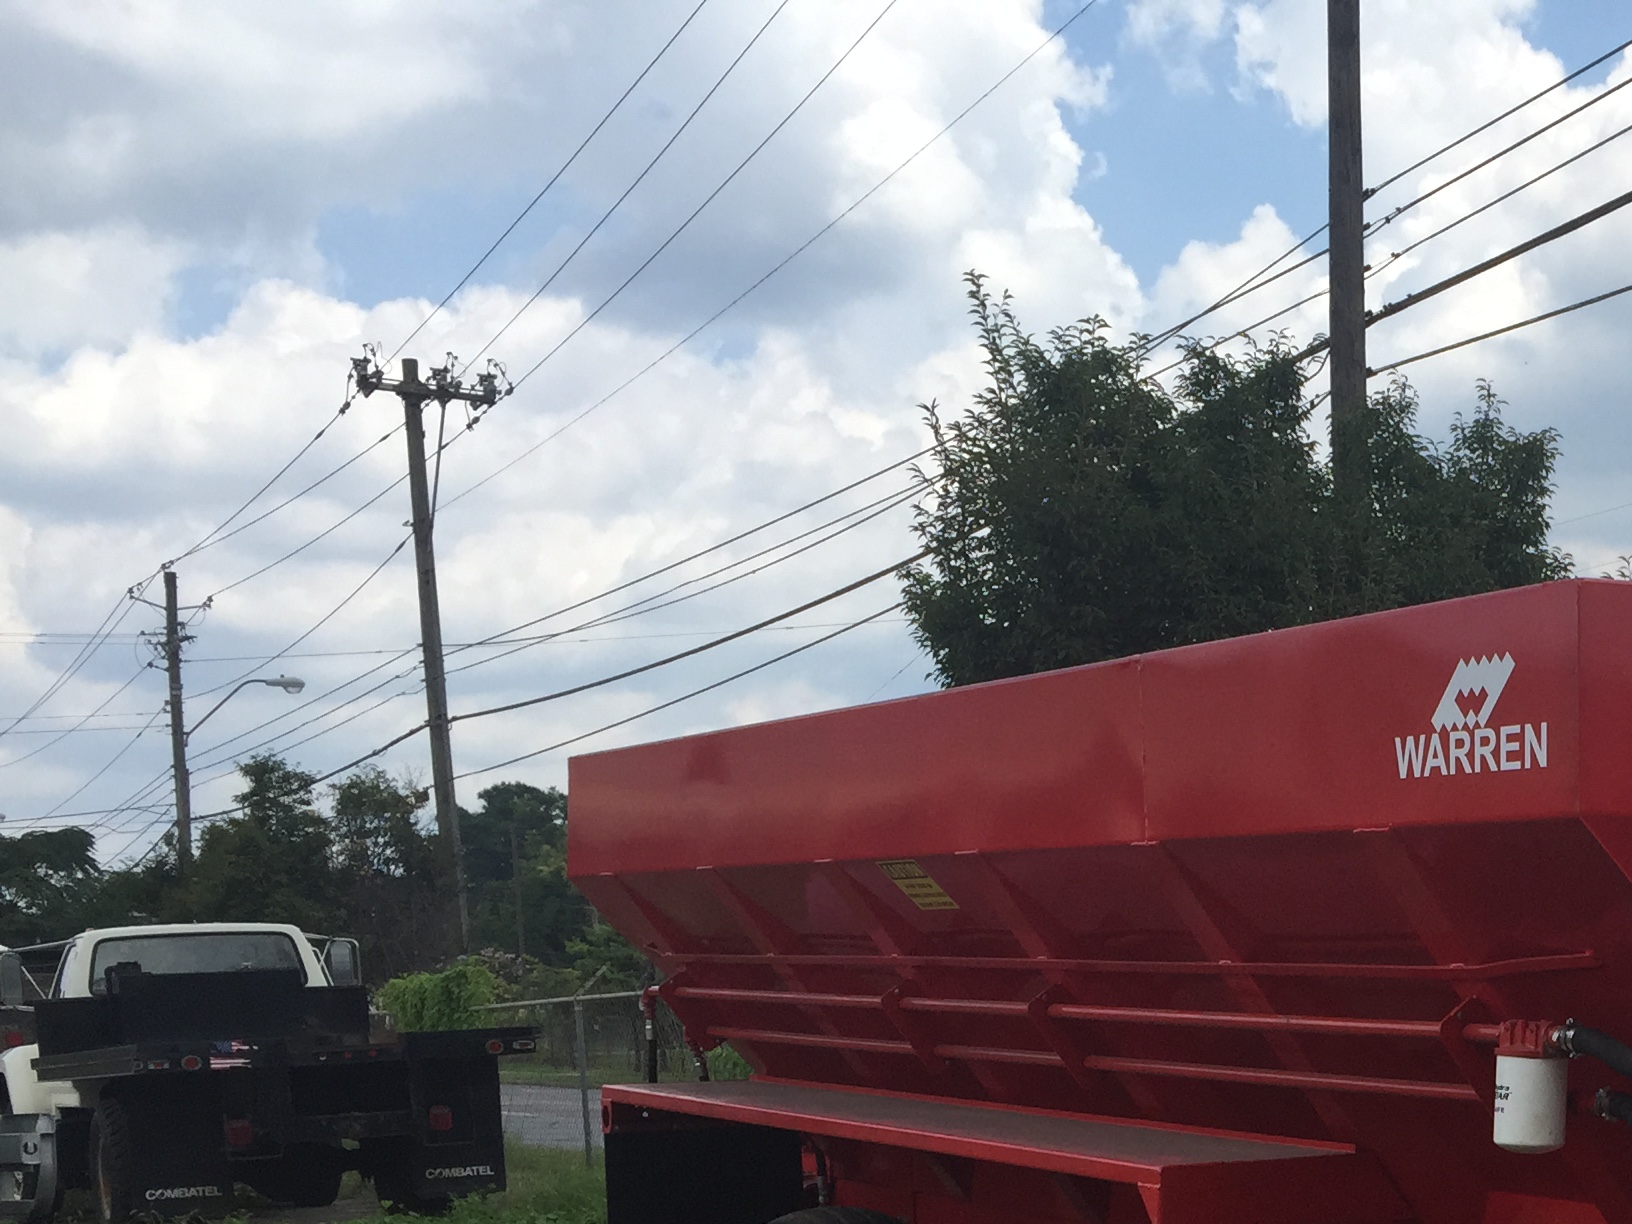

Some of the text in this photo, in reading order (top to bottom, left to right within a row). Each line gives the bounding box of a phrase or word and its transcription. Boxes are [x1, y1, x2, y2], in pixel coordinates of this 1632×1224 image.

[1395, 722, 1548, 779] WARREN
[426, 1166, 495, 1178] COMBATEL
[145, 1186, 222, 1200] COMBATEL
